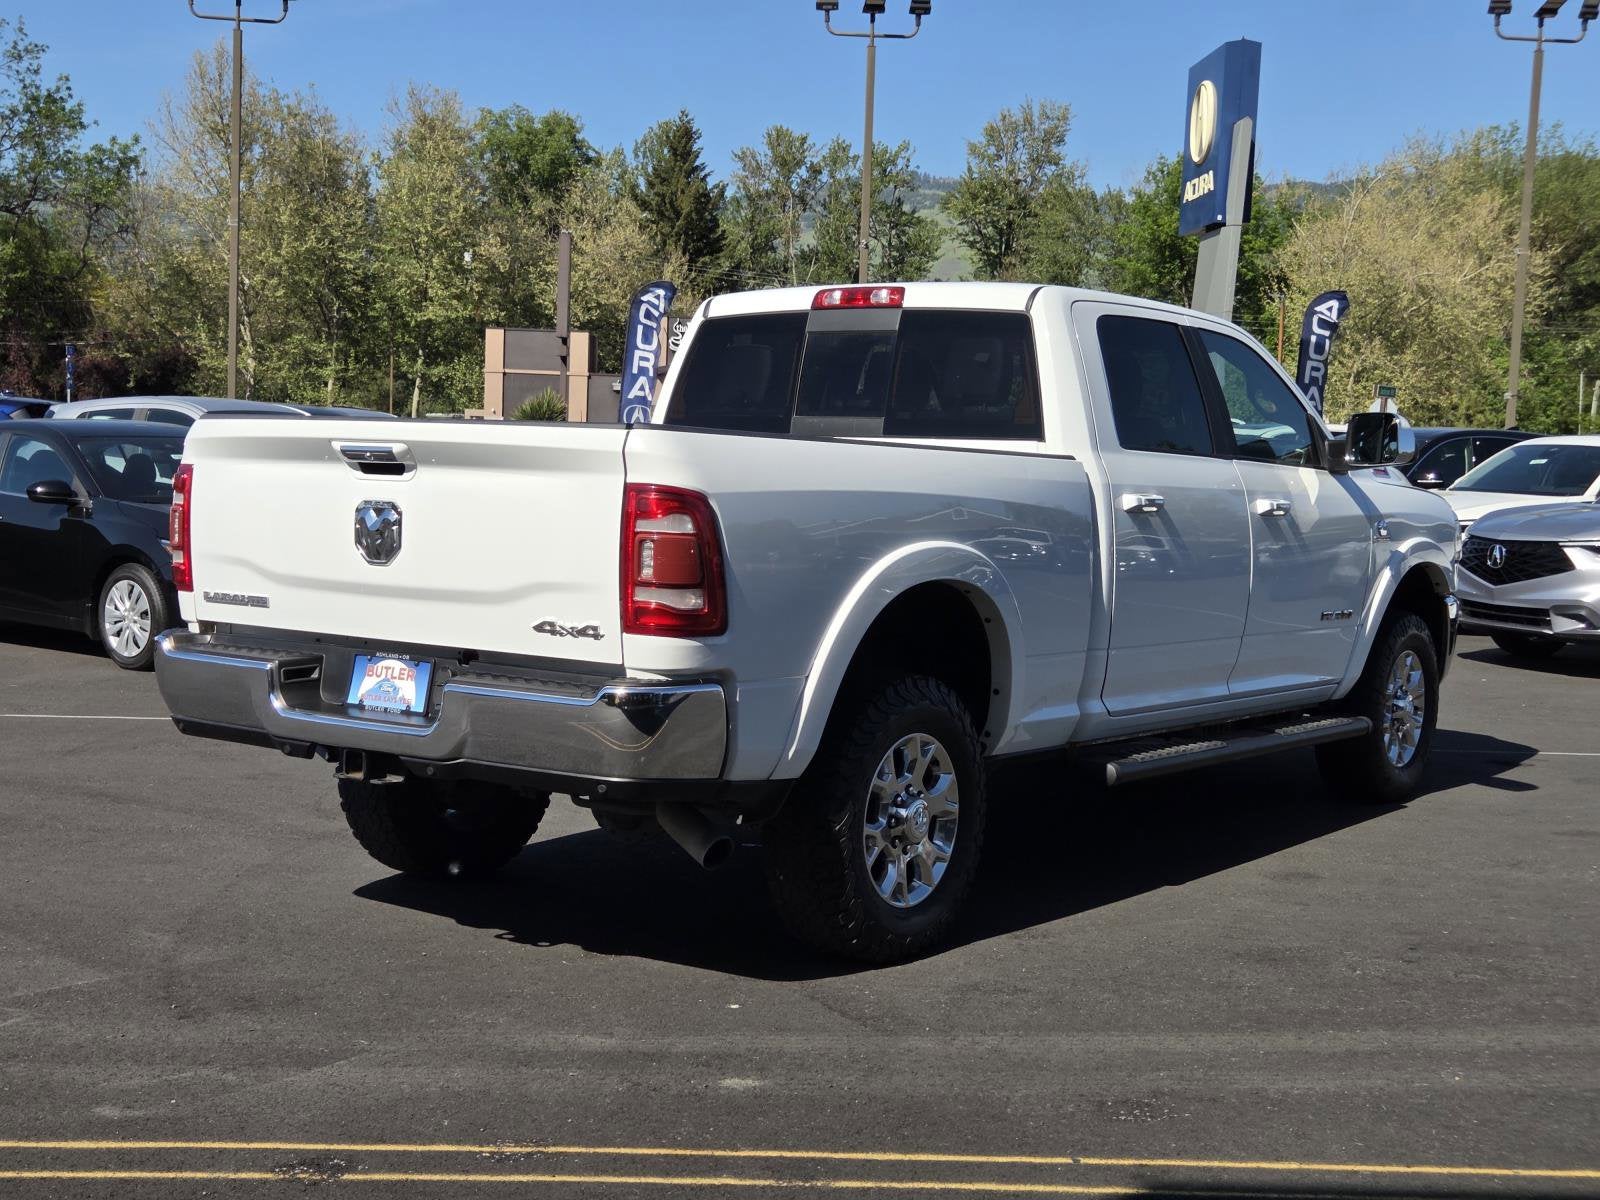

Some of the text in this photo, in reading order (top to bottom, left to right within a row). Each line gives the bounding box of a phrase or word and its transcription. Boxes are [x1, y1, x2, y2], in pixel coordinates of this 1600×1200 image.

[1183, 169, 1215, 204] ACURA
[627, 288, 666, 401] ACURA
[1305, 299, 1340, 411] ACURA
[366, 663, 416, 682] BUTLER
